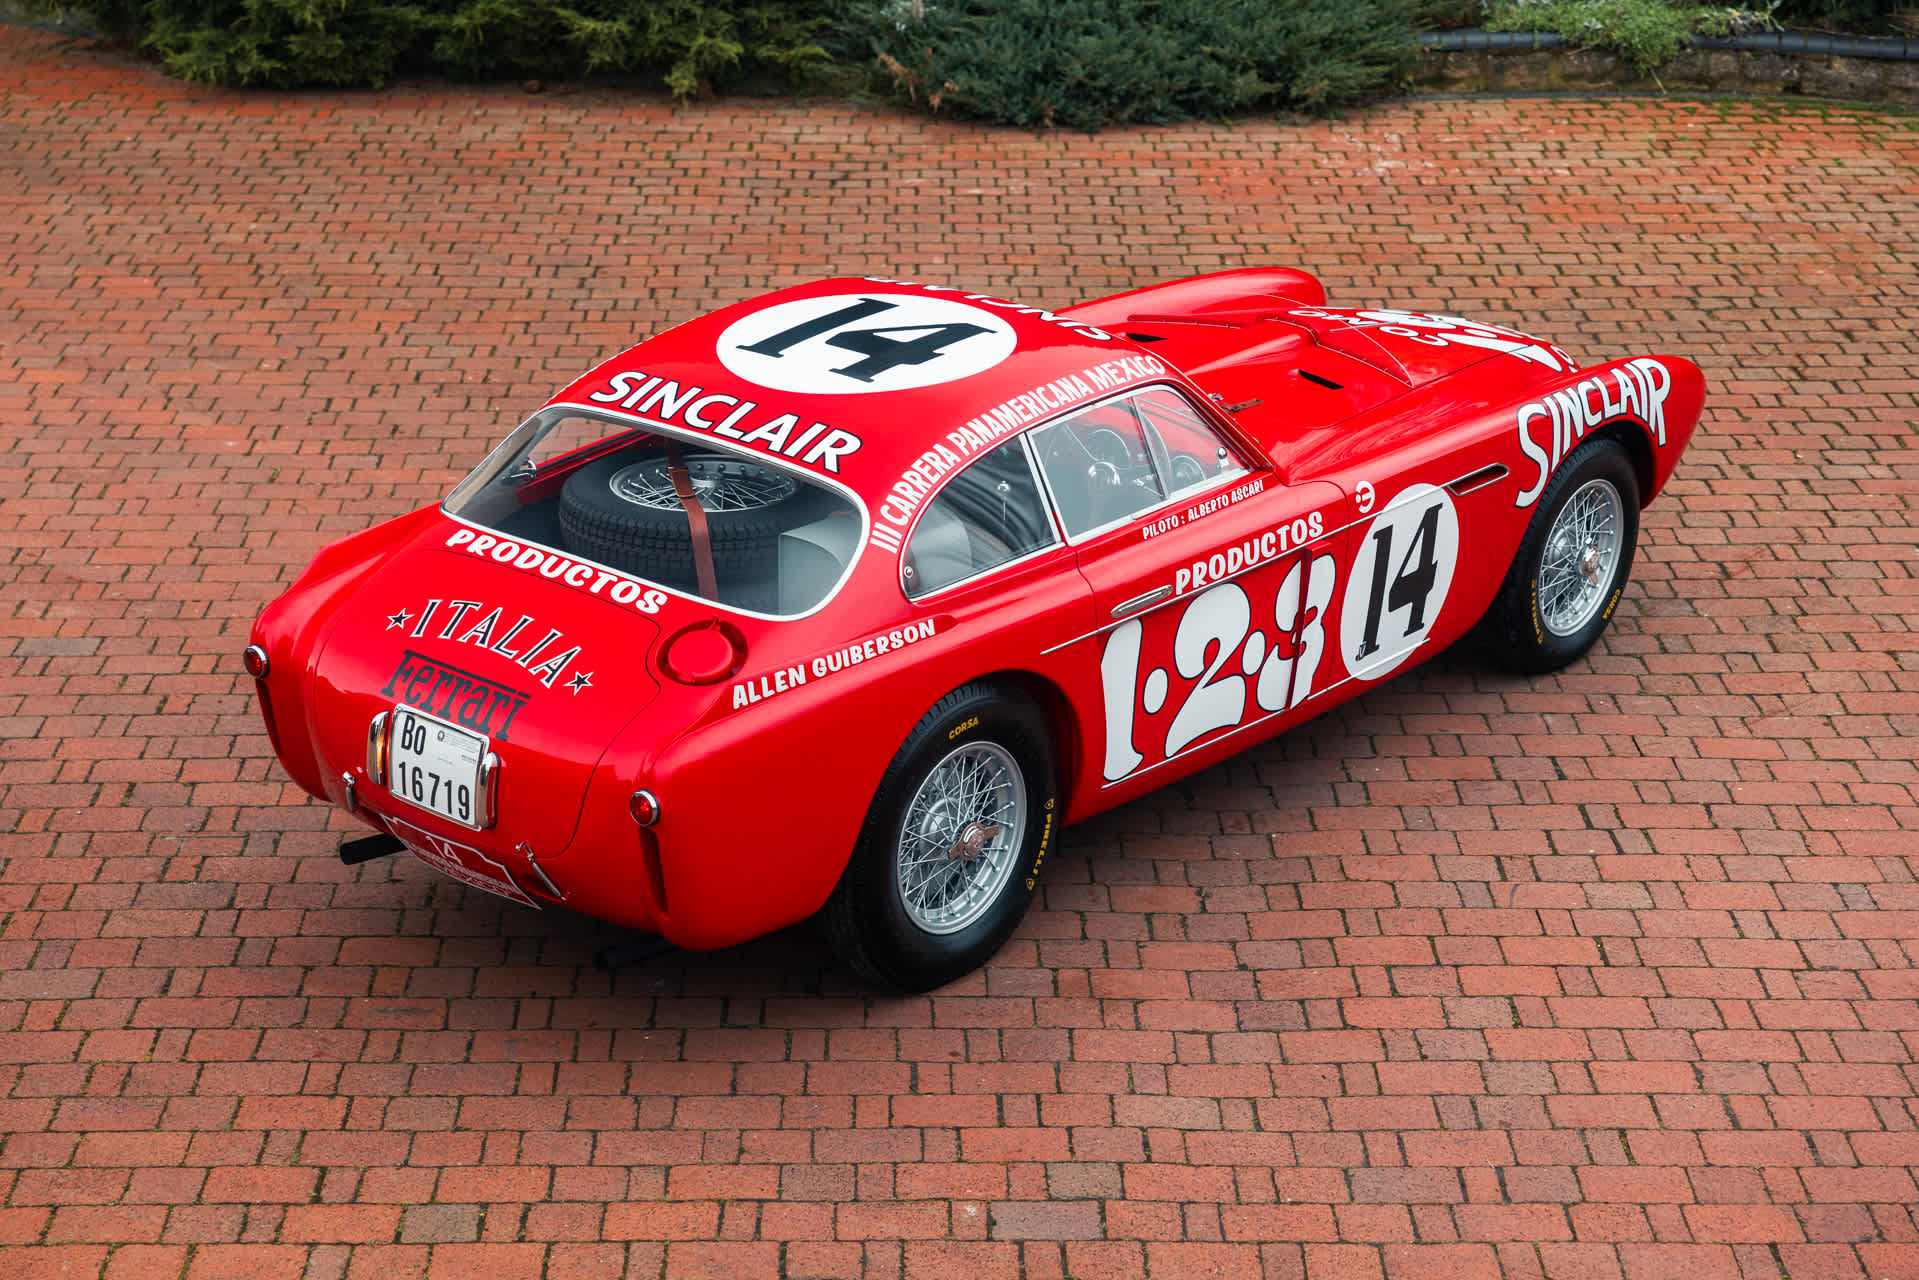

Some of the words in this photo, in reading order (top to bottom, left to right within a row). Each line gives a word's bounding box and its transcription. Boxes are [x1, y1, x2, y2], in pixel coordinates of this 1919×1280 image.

[735, 297, 998, 383] 14
[1083, 354, 1166, 393] MEXICO
[588, 371, 863, 474] SINCLAIR
[946, 374, 1095, 458] PANAMERICANA
[1514, 357, 1671, 509] SINCLAIR
[880, 443, 961, 526] CARRERA
[1142, 514, 1179, 540] PILOTO
[1187, 494, 1229, 522] ALBERTO
[1231, 479, 1264, 504] ASCARI
[445, 529, 668, 614] PRODUCTOS
[869, 522, 902, 554] III
[1175, 511, 1324, 595] PRODUCTOS
[1356, 502, 1443, 661] 14
[410, 599, 582, 689] ITALIA
[732, 664, 807, 709] ALLEN
[812, 618, 936, 678] GUIBERSON
[380, 649, 532, 742] Ferrari
[400, 714, 427, 756] BO
[948, 716, 980, 740] CORSA
[398, 761, 470, 821] 16719
